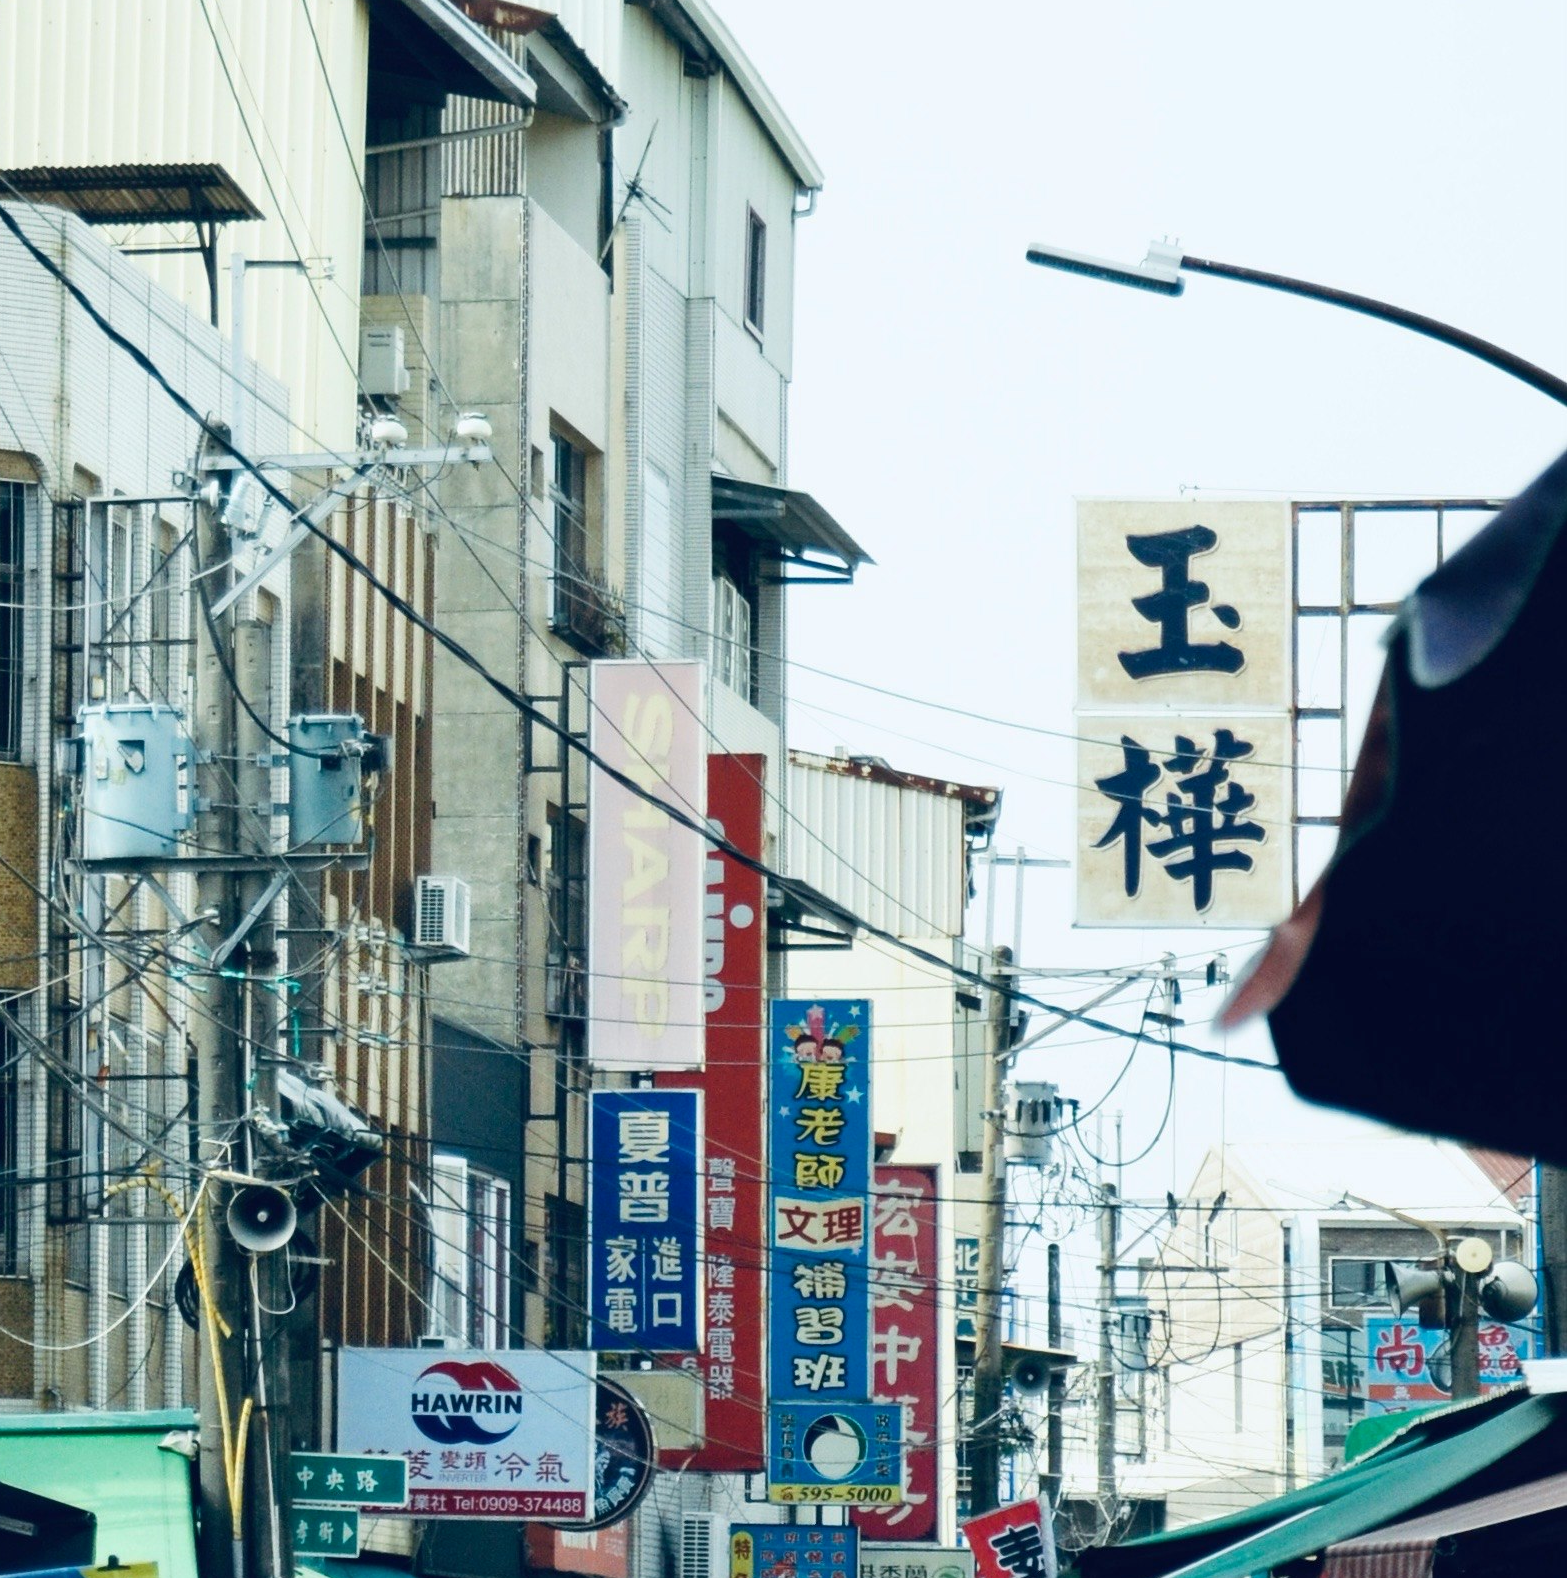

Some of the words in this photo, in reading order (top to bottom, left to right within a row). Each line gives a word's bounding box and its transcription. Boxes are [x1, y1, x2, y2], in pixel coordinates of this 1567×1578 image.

[1090, 524, 1266, 913] 玉樺
[621, 691, 673, 1041] SHARP
[618, 1111, 670, 1223] 夏普
[794, 1062, 846, 1191] 康老師
[777, 1204, 862, 1246] 文理
[605, 1235, 637, 1334] 家電
[651, 1236, 683, 1328] 進口
[707, 1254, 736, 1401] 隆泰電器
[793, 1261, 846, 1392] 補習班
[411, 1393, 523, 1415] HAWRIN
[296, 1465, 379, 1493] 中央路
[452, 1494, 582, 1514] Tel:0909-374488
[494, 1451, 571, 1484] 冷氣
[799, 1486, 893, 1503] 595-5000
